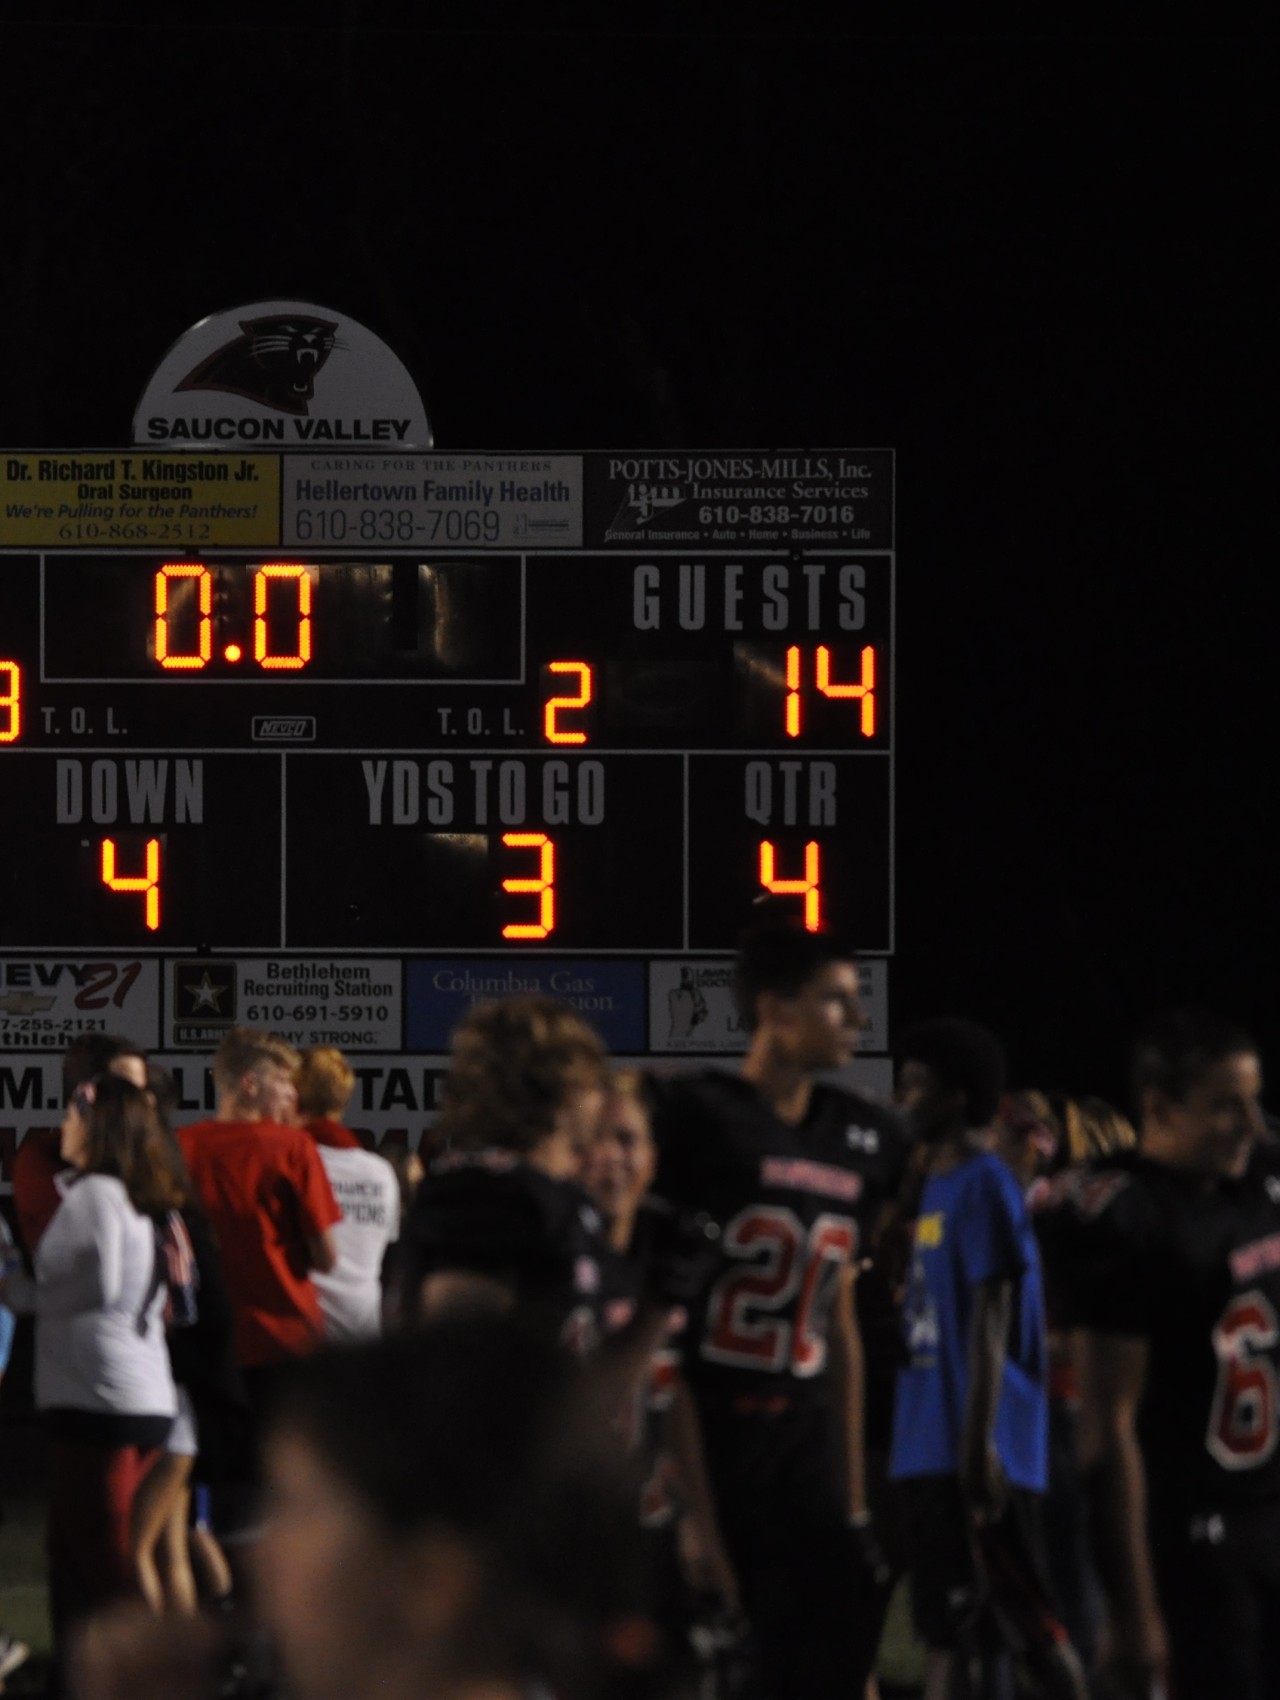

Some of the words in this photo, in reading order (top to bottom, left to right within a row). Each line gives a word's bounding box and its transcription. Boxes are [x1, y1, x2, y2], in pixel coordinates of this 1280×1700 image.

[148, 418, 284, 440] SAUCON
[294, 419, 411, 440] VALLEY
[6, 460, 32, 481] Dr.
[38, 460, 115, 481] Richard
[121, 460, 136, 481] T.
[142, 460, 228, 483] Kingston
[234, 460, 259, 481] Jr.
[311, 460, 375, 471] CARING
[383, 460, 416, 471] FOR
[422, 461, 456, 471] THE
[463, 461, 552, 472] PANTHERS
[608, 459, 833, 484] POTTS-JONES-MILLS,
[838, 459, 872, 479] Inc.
[78, 484, 114, 500] Oral
[120, 485, 193, 502] Surgeon
[296, 479, 417, 501] Hellertown
[423, 480, 494, 507] Family
[500, 480, 570, 502] Health
[692, 482, 786, 499] Insurance
[792, 481, 869, 499] Services
[6, 504, 53, 518] We're
[58, 504, 114, 520] Pulling
[120, 504, 143, 518] for
[147, 504, 175, 518] the
[179, 504, 257, 518] Panthers!
[699, 506, 855, 524] 610-838-7016
[59, 523, 210, 540] 610-868-2512
[296, 509, 500, 541] 610-838-7069
[605, 529, 645, 540] General
[648, 529, 700, 540] Insurance
[712, 529, 736, 540] Auto
[749, 529, 779, 540] Home
[791, 529, 839, 540] Business
[851, 528, 871, 540] Life
[632, 564, 866, 631] GUESTS
[153, 562, 313, 671] 0.0
[543, 660, 593, 745] 2
[784, 644, 876, 739] 14
[56, 759, 203, 824] DOWN
[361, 760, 454, 826] YDS
[470, 760, 526, 825] TO
[542, 760, 605, 825] GO
[744, 761, 838, 827] QTR
[100, 837, 160, 932] 4
[501, 831, 555, 940] 3
[757, 840, 820, 933] 4
[267, 963, 370, 980] Bethlehem
[432, 969, 541, 992] Columbia
[550, 971, 594, 992] Gas
[74, 961, 142, 1010] 21
[244, 980, 330, 1000] Recruiting
[334, 980, 393, 997] Station
[247, 1006, 388, 1021] 610-691-5910
[310, 1032, 377, 1044] STRONG.
